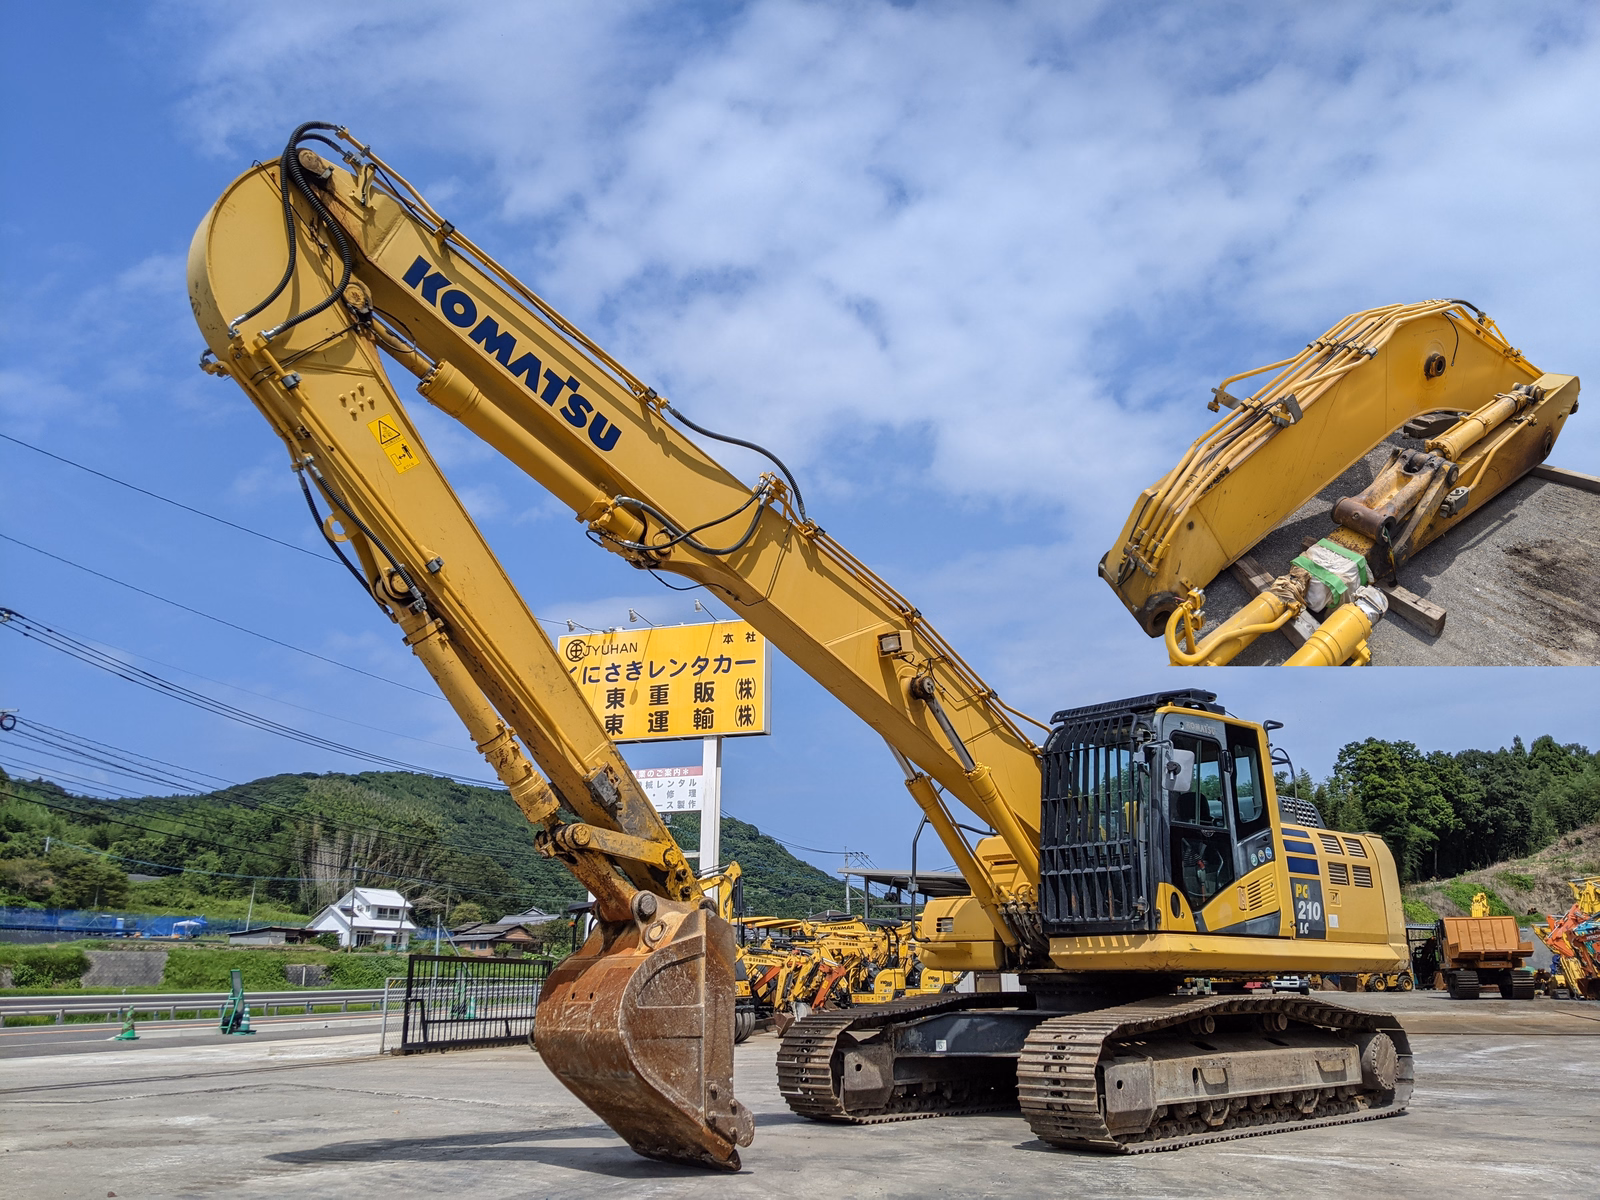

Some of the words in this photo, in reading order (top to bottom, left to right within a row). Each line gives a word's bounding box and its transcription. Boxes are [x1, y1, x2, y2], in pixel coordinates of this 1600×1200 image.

[402, 255, 622, 452] KOMATSU
[722, 631, 757, 645] 本社
[583, 642, 638, 657] JYUHAN
[1295, 883, 1309, 898] PC
[1297, 900, 1321, 921] 210
[1299, 922, 1309, 935] LC
